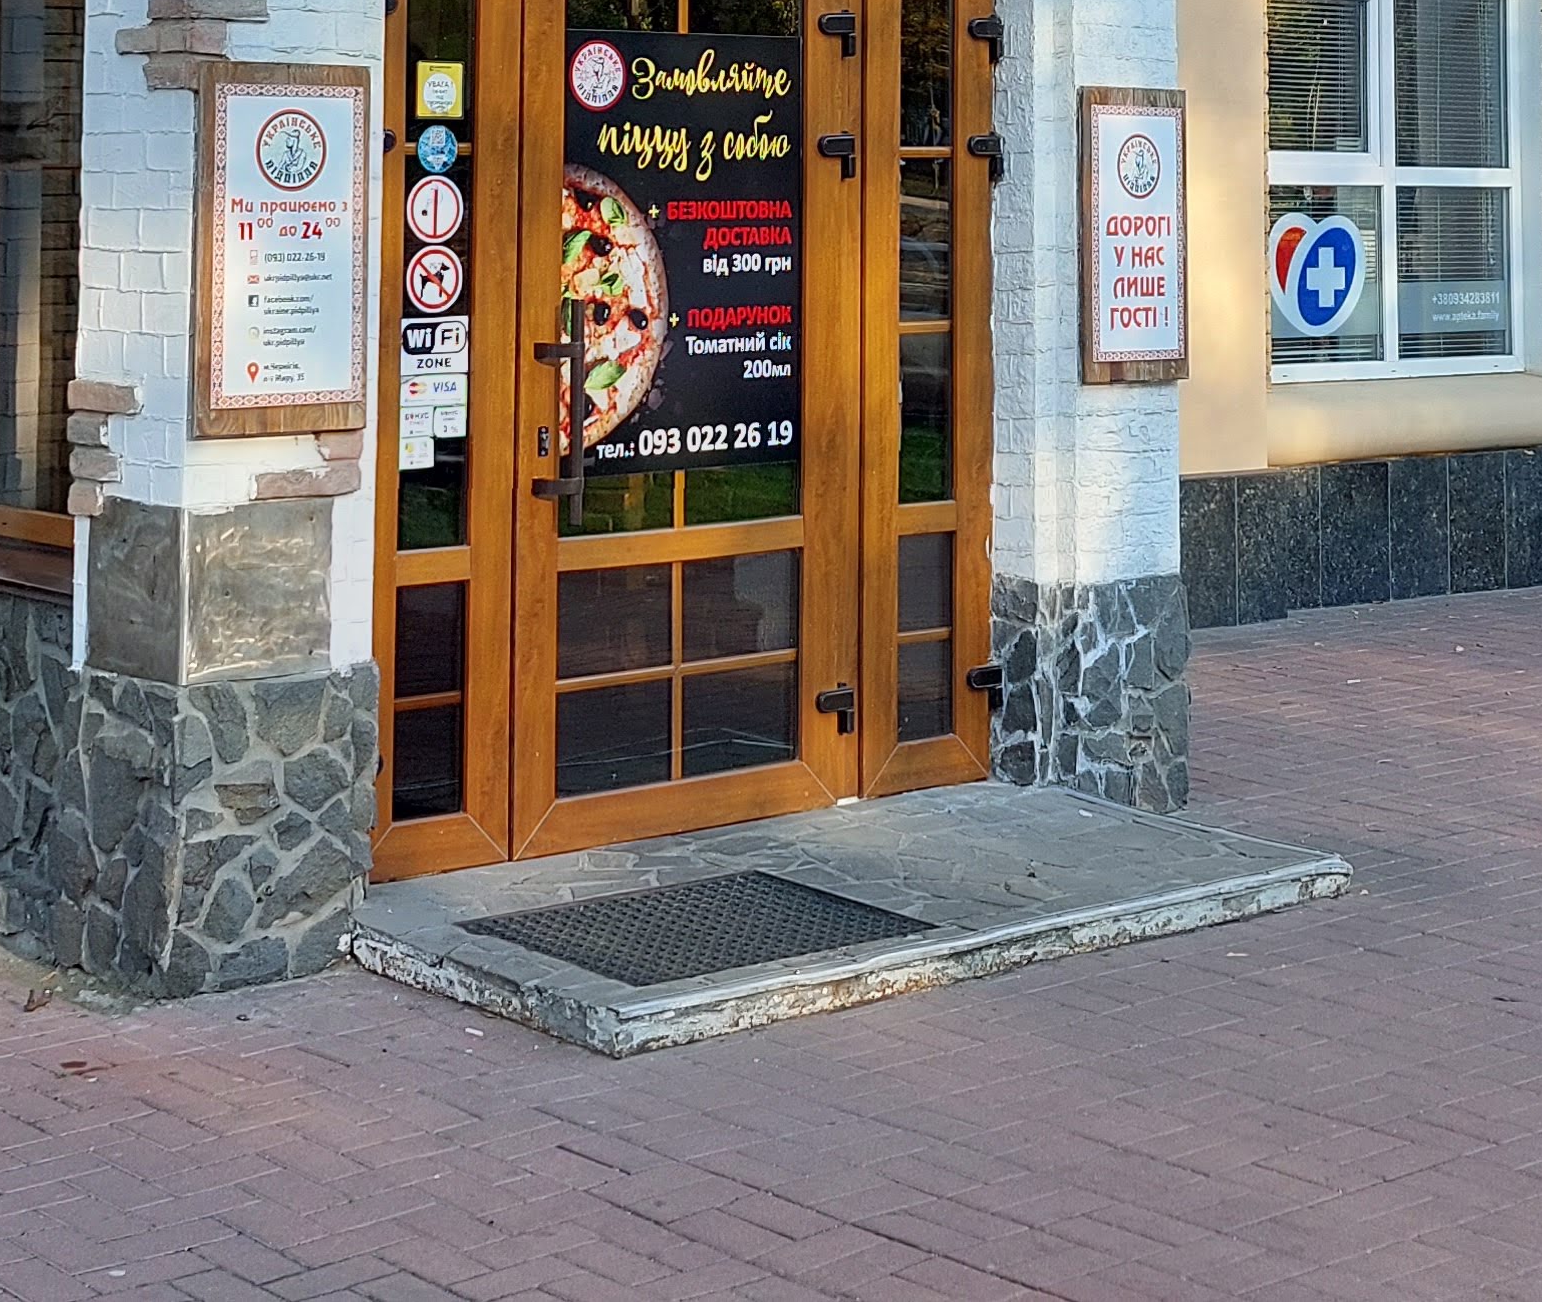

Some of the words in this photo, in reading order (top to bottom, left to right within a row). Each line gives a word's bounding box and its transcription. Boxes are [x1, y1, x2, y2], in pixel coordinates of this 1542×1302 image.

[631, 49, 792, 100] Замовляйте
[597, 121, 692, 172] піццу
[695, 130, 717, 181] з
[723, 109, 792, 161] собою
[231, 198, 254, 213] Ми
[260, 201, 336, 216] працюємо
[666, 200, 792, 220] БЕЗКОШТОВНА
[238, 222, 253, 241] 11
[279, 225, 297, 237] до
[301, 221, 323, 240] 24
[703, 225, 792, 251] ДОСТАВКА
[1106, 215, 1171, 238] ДОРОГІ
[703, 253, 730, 277] від
[731, 253, 762, 273] 300
[764, 256, 792, 276] грн
[1114, 246, 1125, 267] У
[1131, 246, 1165, 268] НАС
[1113, 276, 1166, 299] ЛИШЕ
[687, 305, 792, 331] ПОДАРУНОК
[1110, 307, 1157, 331] ГОСТІ
[685, 331, 766, 356] Томатний
[769, 330, 792, 351] сік
[416, 358, 451, 369] ZONE
[743, 359, 792, 379] 200мл
[433, 381, 457, 393] VISA
[639, 428, 681, 456] 093
[686, 423, 728, 453] 022
[733, 422, 761, 449] 26
[767, 420, 793, 447] 19
